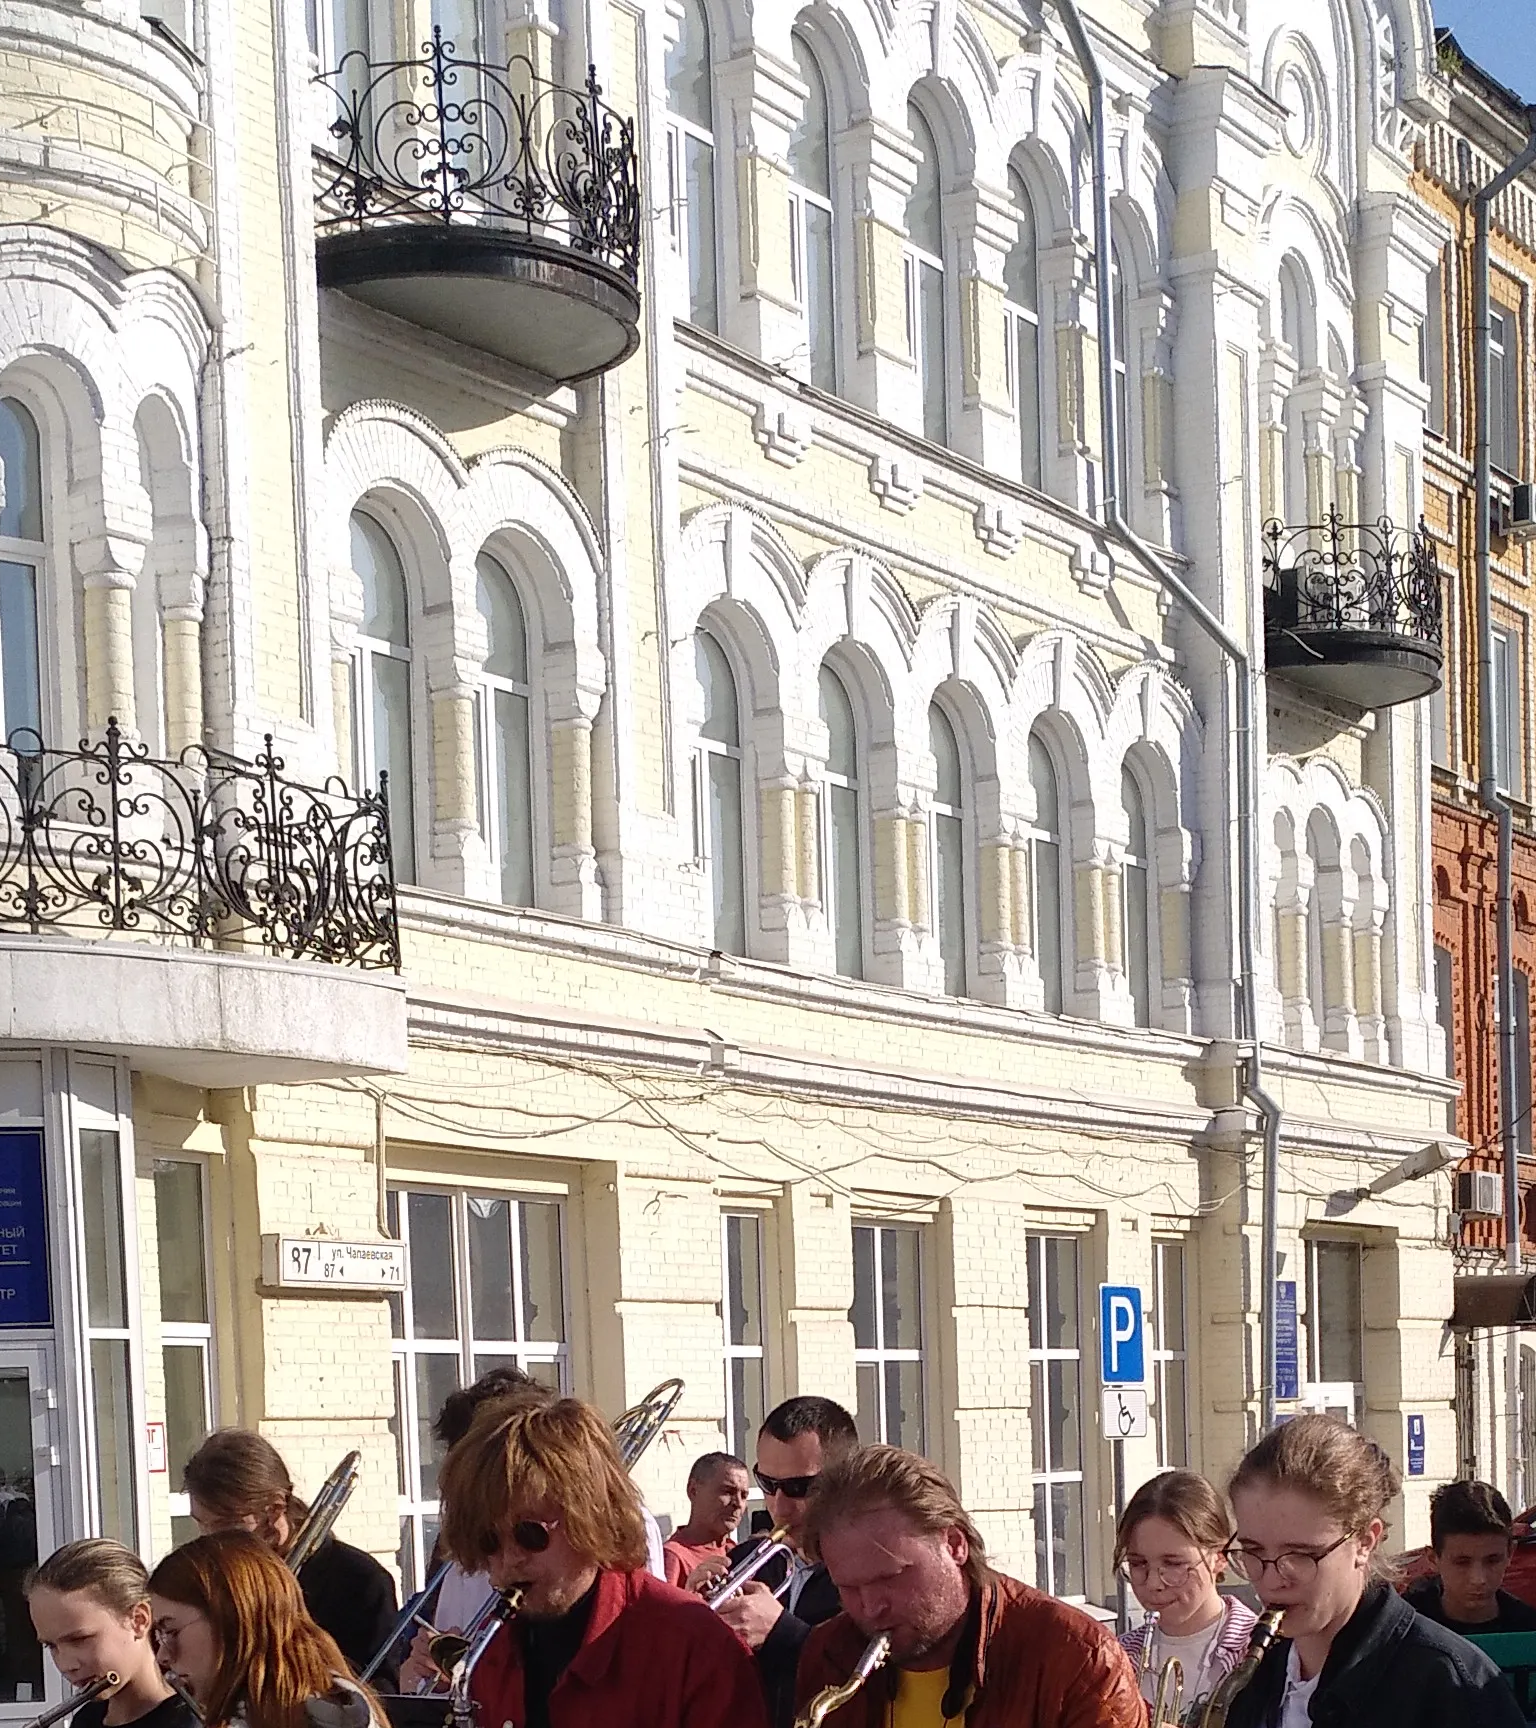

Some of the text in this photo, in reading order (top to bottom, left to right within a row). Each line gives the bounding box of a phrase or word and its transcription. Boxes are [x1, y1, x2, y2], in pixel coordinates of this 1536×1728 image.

[291, 1246, 312, 1275] 87
[331, 1246, 393, 1261] ул. Чапаевская
[324, 1263, 400, 1281] 87 71
[1110, 1295, 1135, 1373] P
